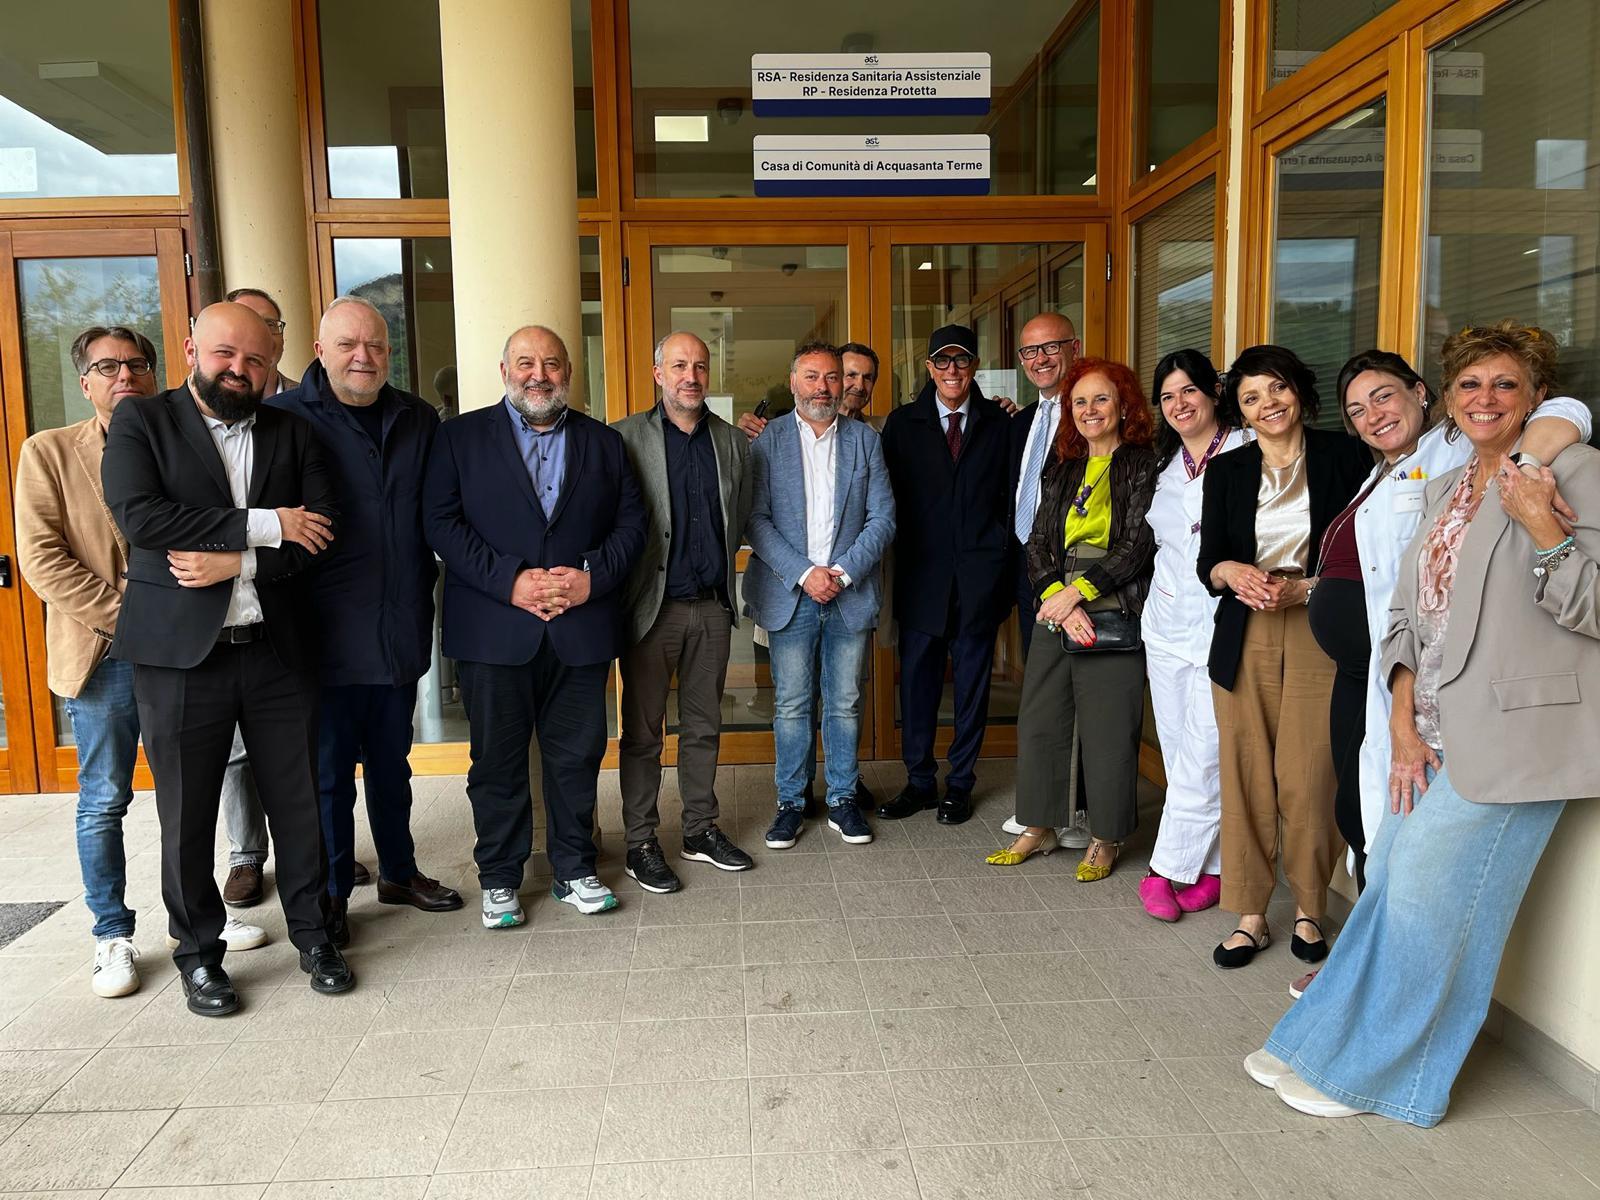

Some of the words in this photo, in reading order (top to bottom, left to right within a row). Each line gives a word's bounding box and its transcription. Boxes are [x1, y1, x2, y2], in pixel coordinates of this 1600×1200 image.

[864, 54, 879, 63] ast
[757, 71, 787, 82] RSA-
[790, 71, 849, 82] Residenza
[851, 71, 902, 82] Sanitaria
[904, 70, 981, 81] Assistenziale
[802, 86, 818, 96] RP
[828, 86, 888, 96] Residenza
[890, 85, 937, 96] Protetta
[865, 136, 880, 145] ast
[761, 161, 790, 171] Casa
[792, 161, 803, 171] di
[805, 160, 860, 171] Comunità
[862, 160, 873, 171] di
[876, 160, 944, 173] Acquasanta
[946, 160, 983, 170] Terme
